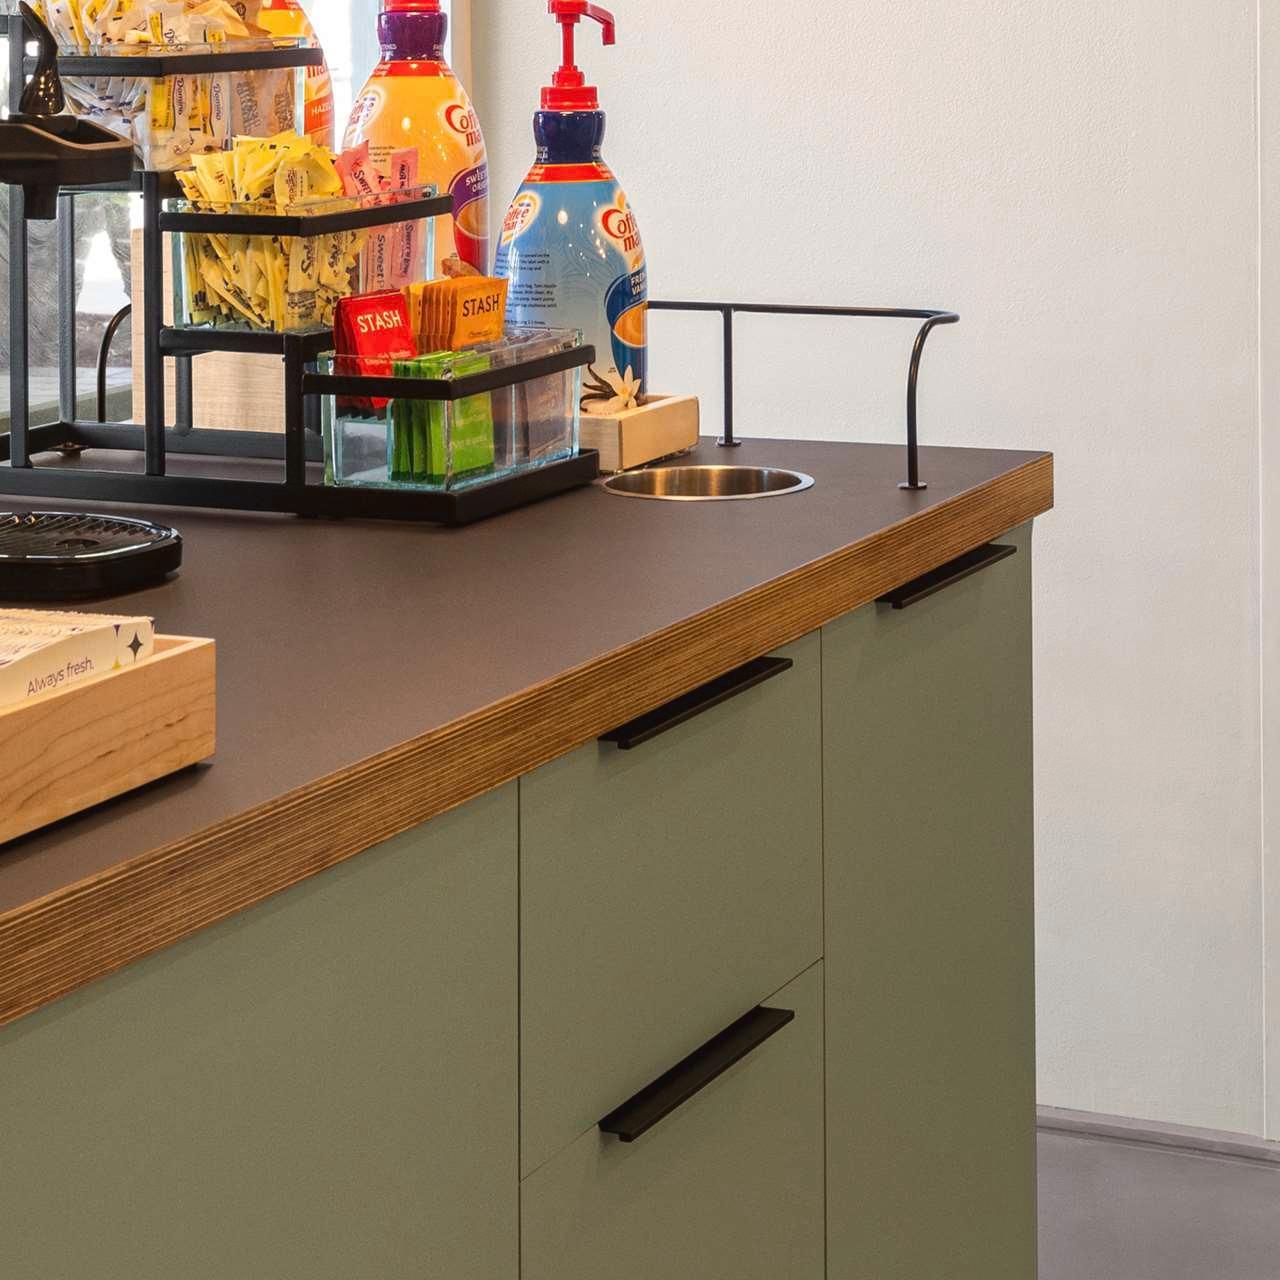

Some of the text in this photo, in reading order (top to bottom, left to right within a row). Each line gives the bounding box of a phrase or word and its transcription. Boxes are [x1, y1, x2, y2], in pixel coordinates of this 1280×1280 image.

[462, 294, 500, 317] STASH
[356, 310, 403, 333] STASH
[27, 656, 94, 696] Always fresh.
